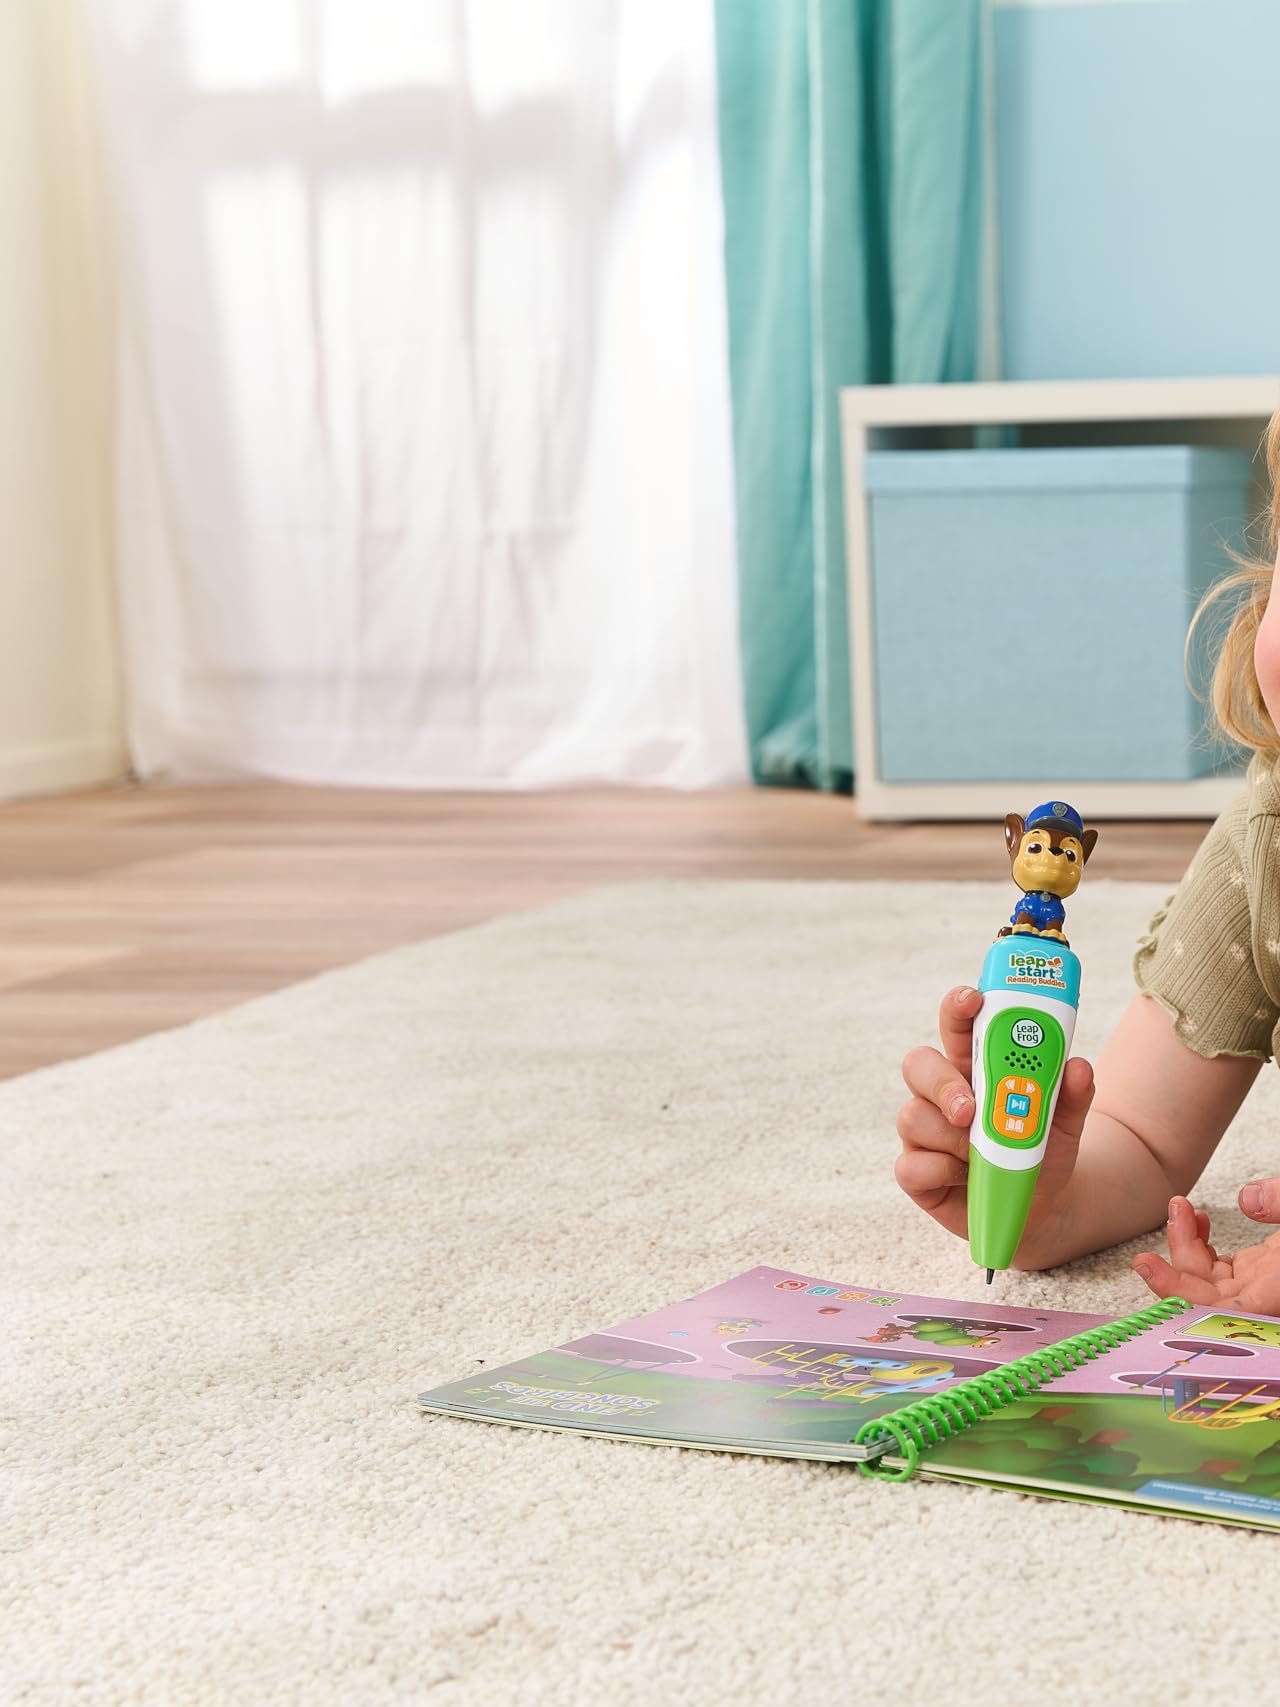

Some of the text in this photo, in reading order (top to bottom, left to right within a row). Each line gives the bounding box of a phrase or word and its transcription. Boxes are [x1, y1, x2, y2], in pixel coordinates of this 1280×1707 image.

[1010, 955, 1047, 968] leap
[1018, 966, 1056, 979] start
[1007, 976, 1066, 988] Reading Buddies
[1016, 1025, 1039, 1034] Leap
[1017, 1033, 1039, 1043] Frog
[490, 1381, 659, 1410] SONGBIRDS
[551, 1401, 625, 1416] FIND
